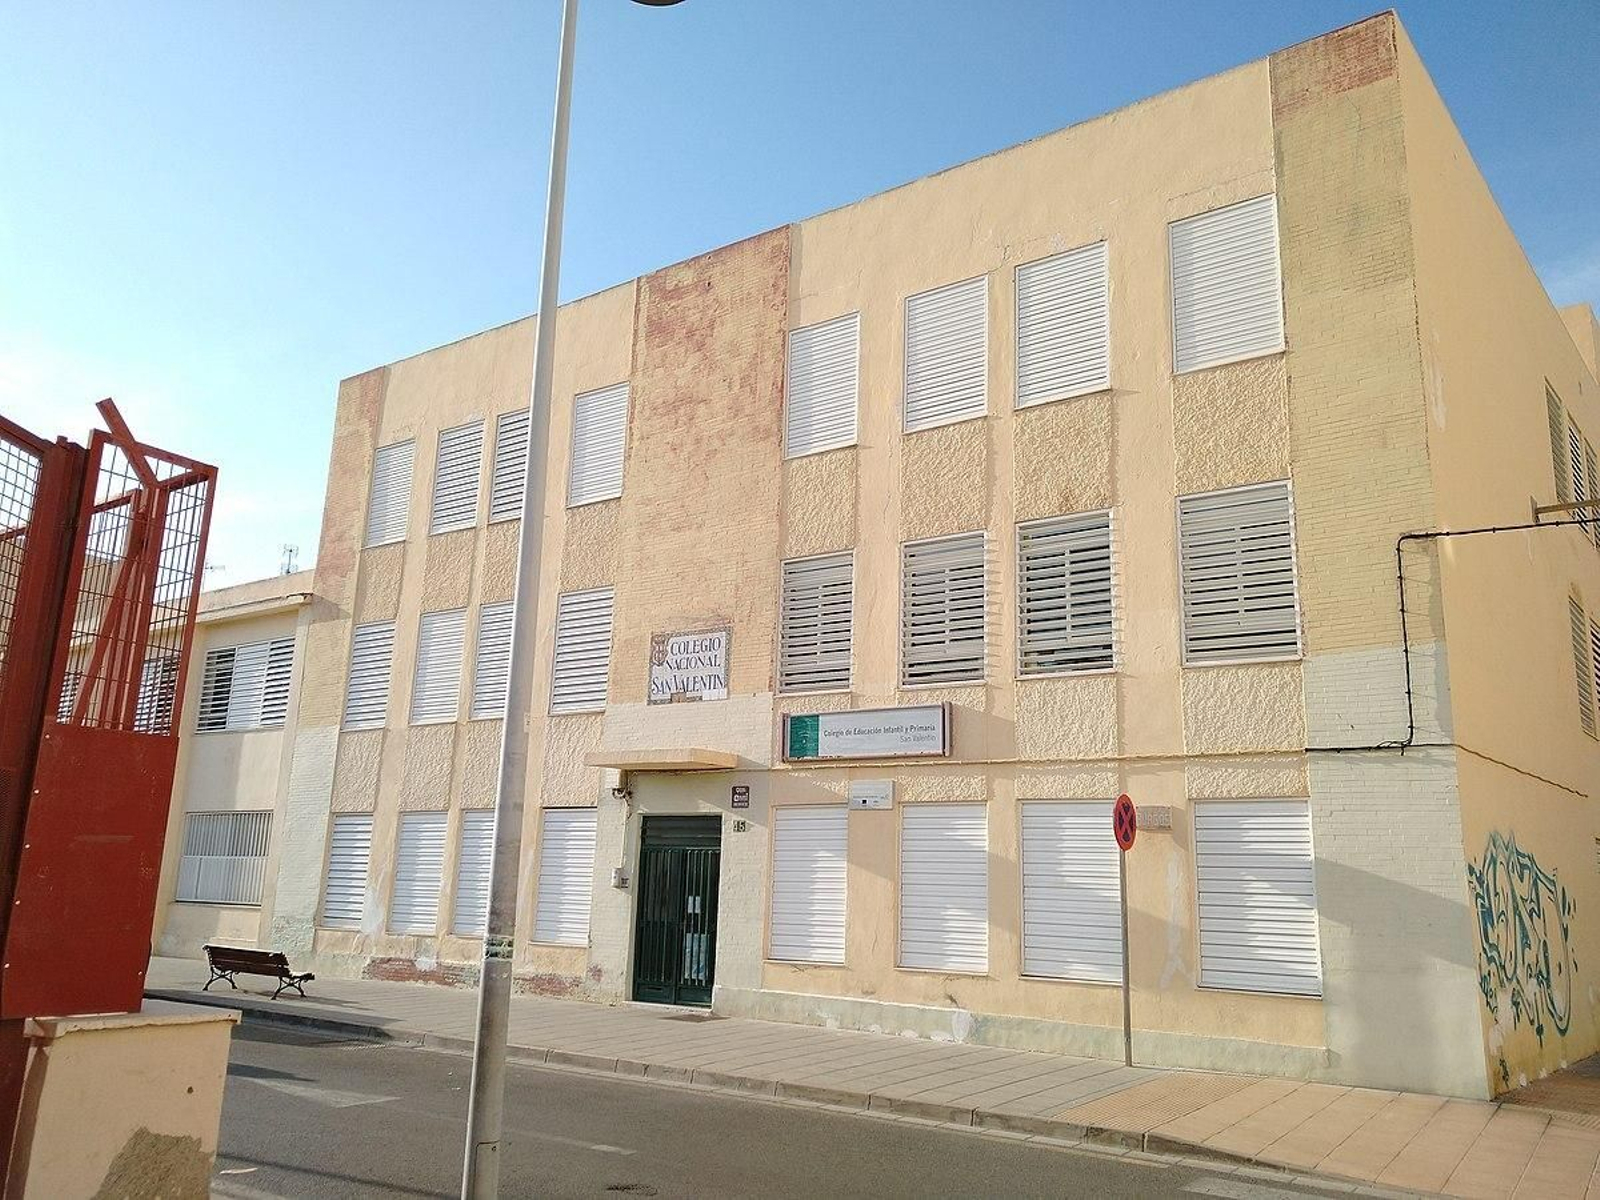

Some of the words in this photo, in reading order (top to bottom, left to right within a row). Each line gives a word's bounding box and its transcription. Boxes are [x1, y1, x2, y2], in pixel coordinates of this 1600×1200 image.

[670, 636, 721, 657] COLEGIO
[665, 654, 721, 671] NACIONAL
[883, 724, 904, 734] Infantil
[909, 723, 936, 733] Primaria
